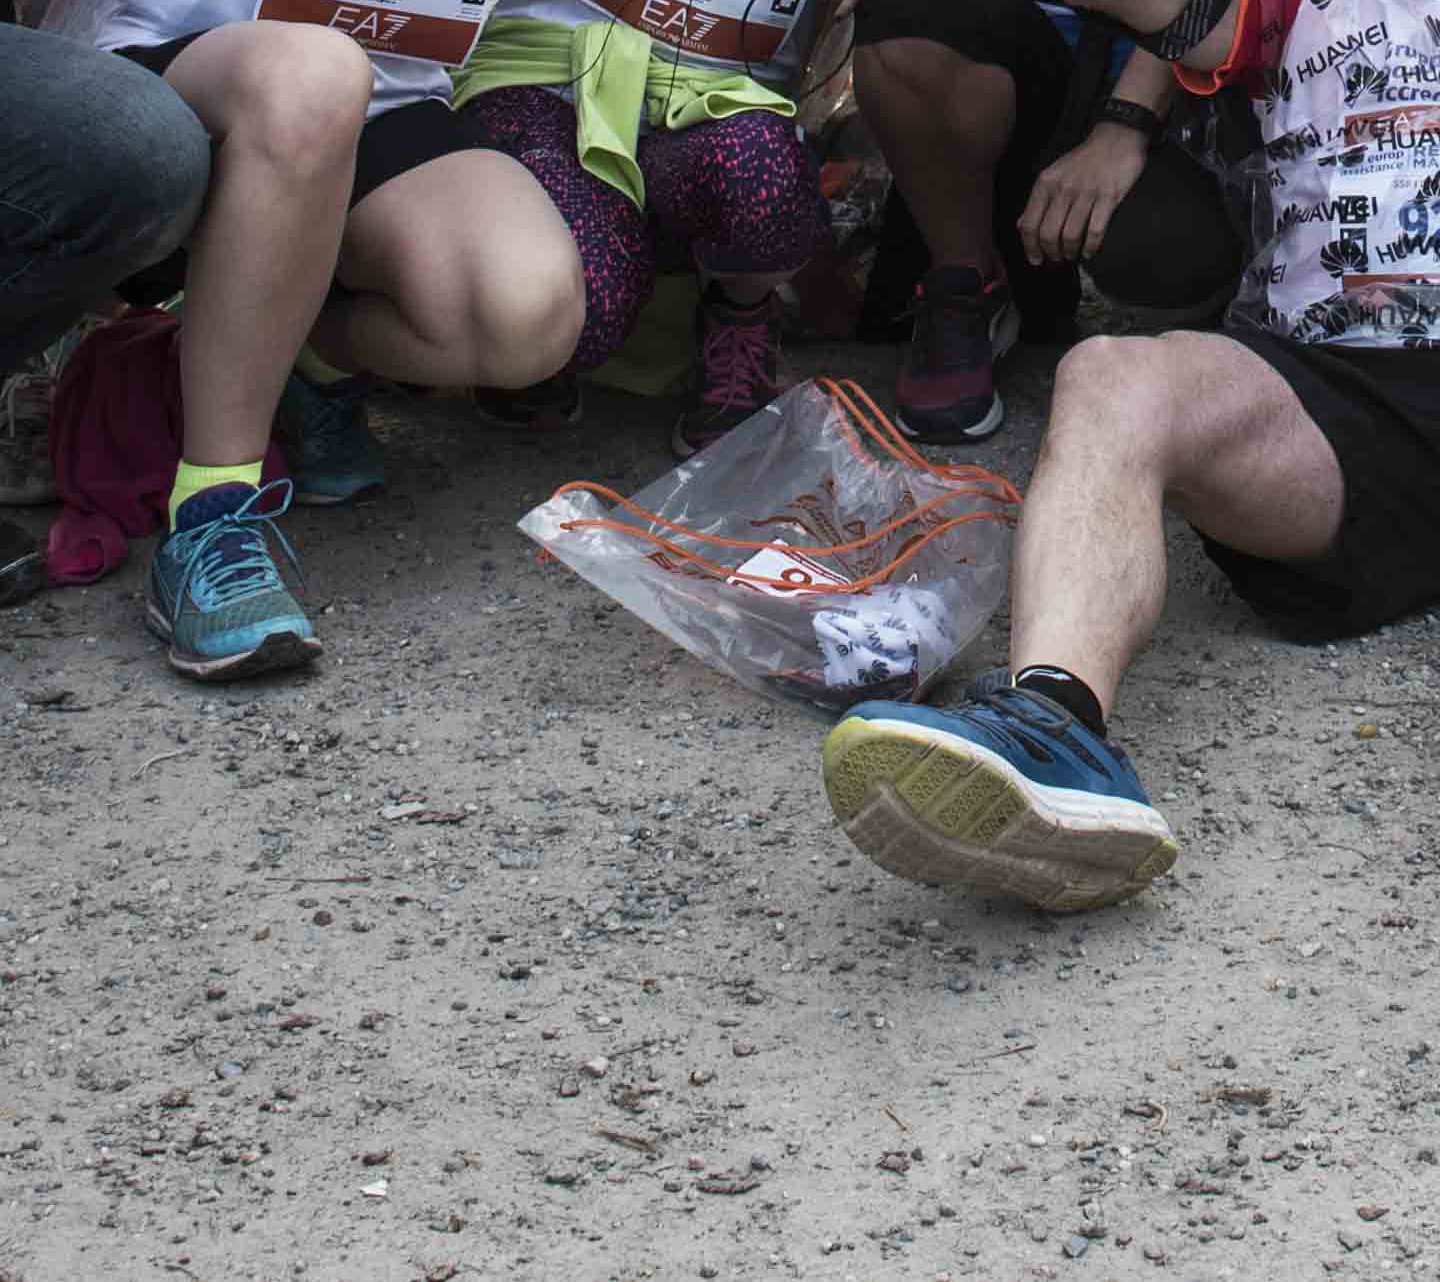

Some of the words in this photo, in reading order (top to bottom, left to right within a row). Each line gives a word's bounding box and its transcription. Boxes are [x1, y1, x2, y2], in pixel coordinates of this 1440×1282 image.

[328, 5, 412, 40] EA7
[1296, 21, 1388, 83] HUAWEI
[1367, 150, 1405, 163] europ
